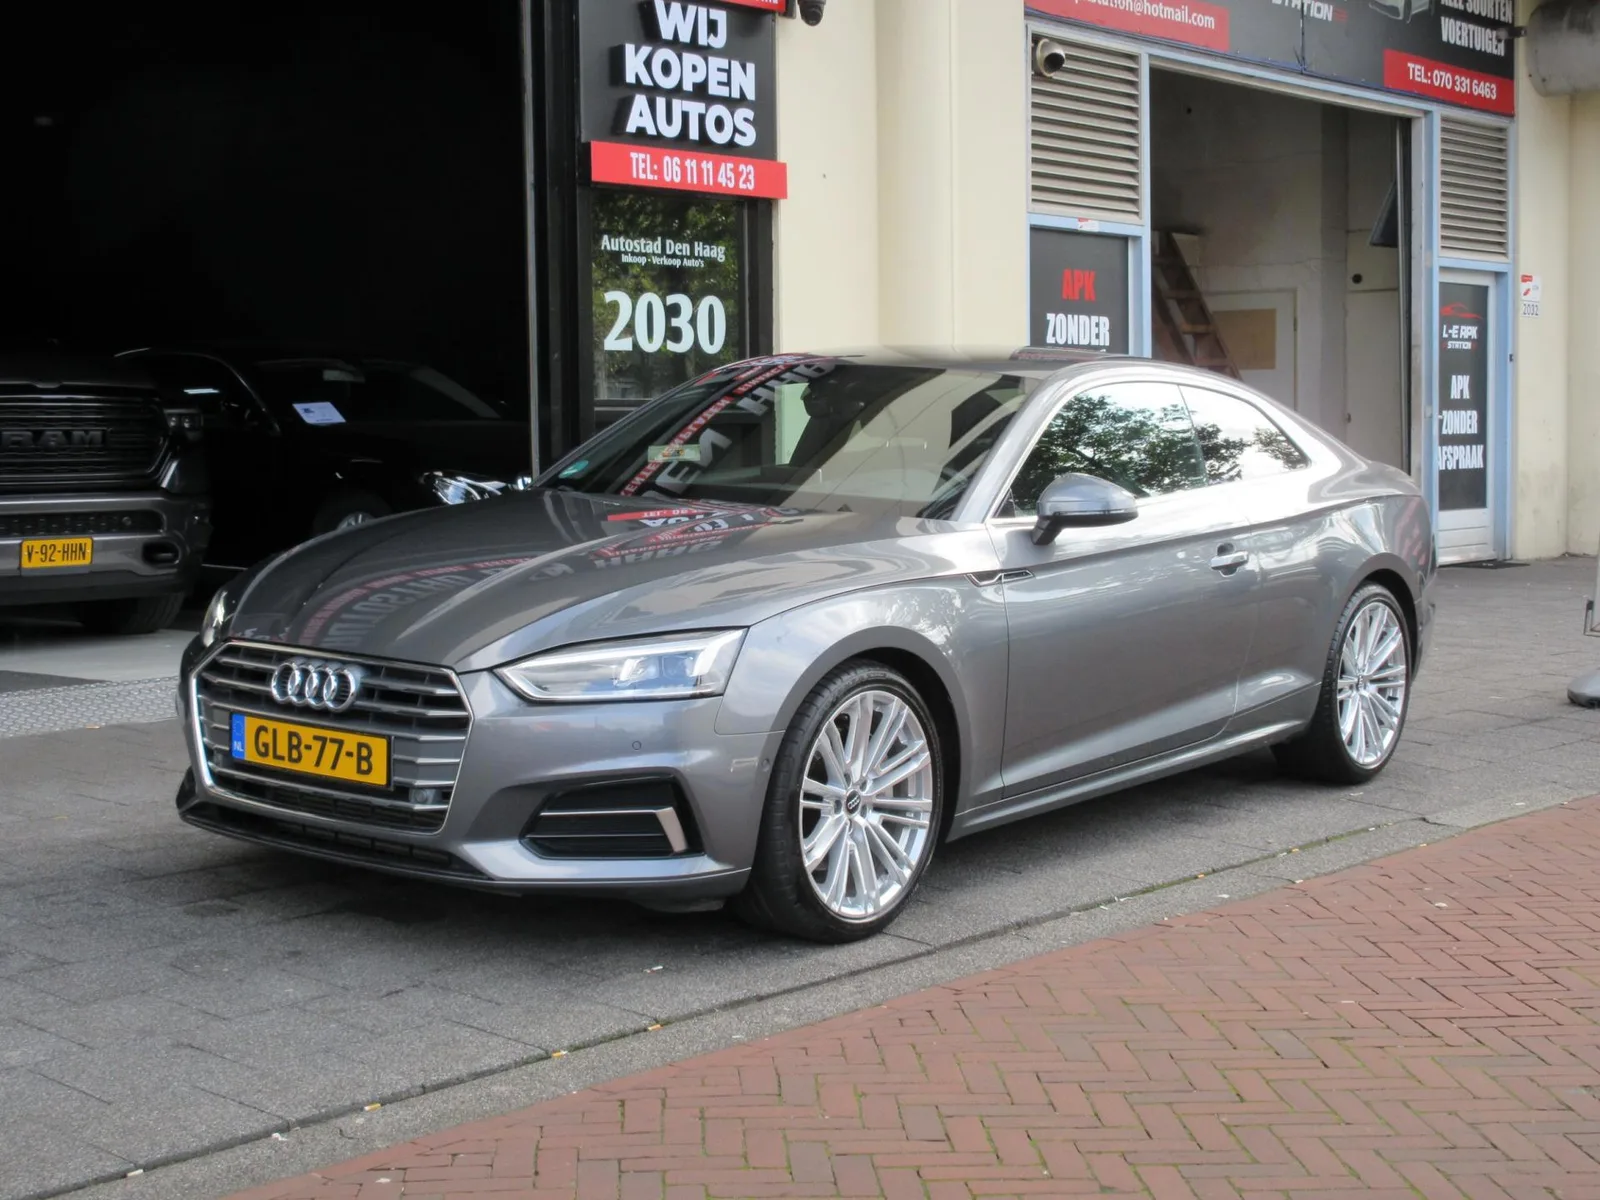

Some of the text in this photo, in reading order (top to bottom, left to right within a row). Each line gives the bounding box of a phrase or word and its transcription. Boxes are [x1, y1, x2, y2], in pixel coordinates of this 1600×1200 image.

[655, 0, 727, 49] WIJ
[625, 43, 756, 101] KOPEN
[1407, 62, 1497, 100] TEL: 070 331 6463
[625, 94, 757, 147] AUTOS
[630, 152, 755, 190] TEL: 06 11 11 45 23
[601, 234, 726, 262] Autostad Den Haag
[621, 253, 705, 268] Inkoop Verkoop Auto's
[1061, 268, 1097, 302] APK
[603, 290, 727, 355] 2030
[1046, 313, 1110, 346] ZONDER
[1450, 375, 1470, 400] APK
[1, 430, 103, 448] RAM
[1441, 410, 1478, 435] ZONDER
[26, 543, 88, 563] V-92-HHN
[233, 740, 245, 752] NL
[254, 724, 373, 776] GLB-77-B
